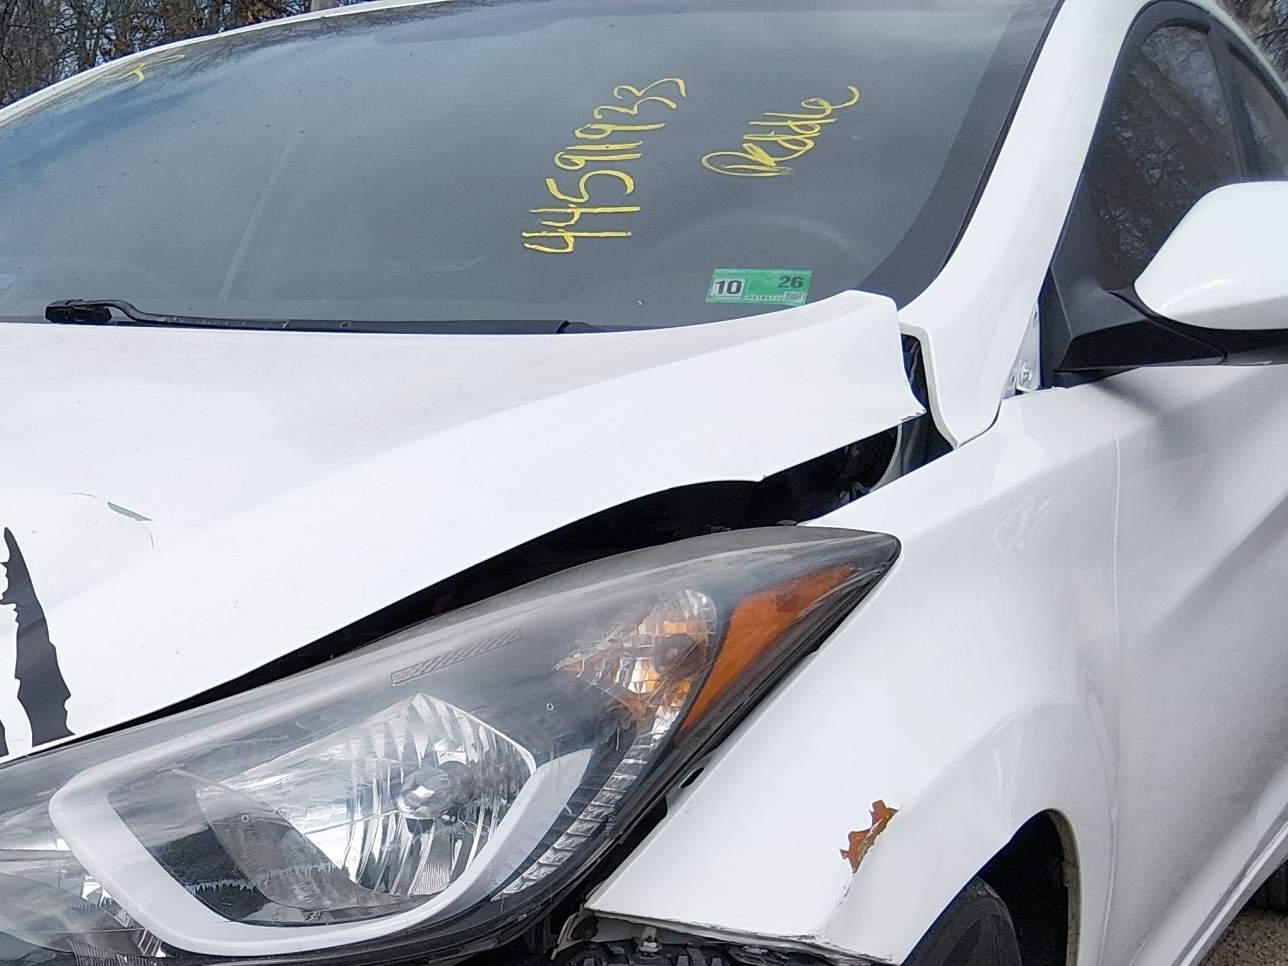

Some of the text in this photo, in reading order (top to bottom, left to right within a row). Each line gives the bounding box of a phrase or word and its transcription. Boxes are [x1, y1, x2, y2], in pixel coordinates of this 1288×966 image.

[521, 77, 687, 254] 44591933
[715, 275, 804, 295] 10 26
